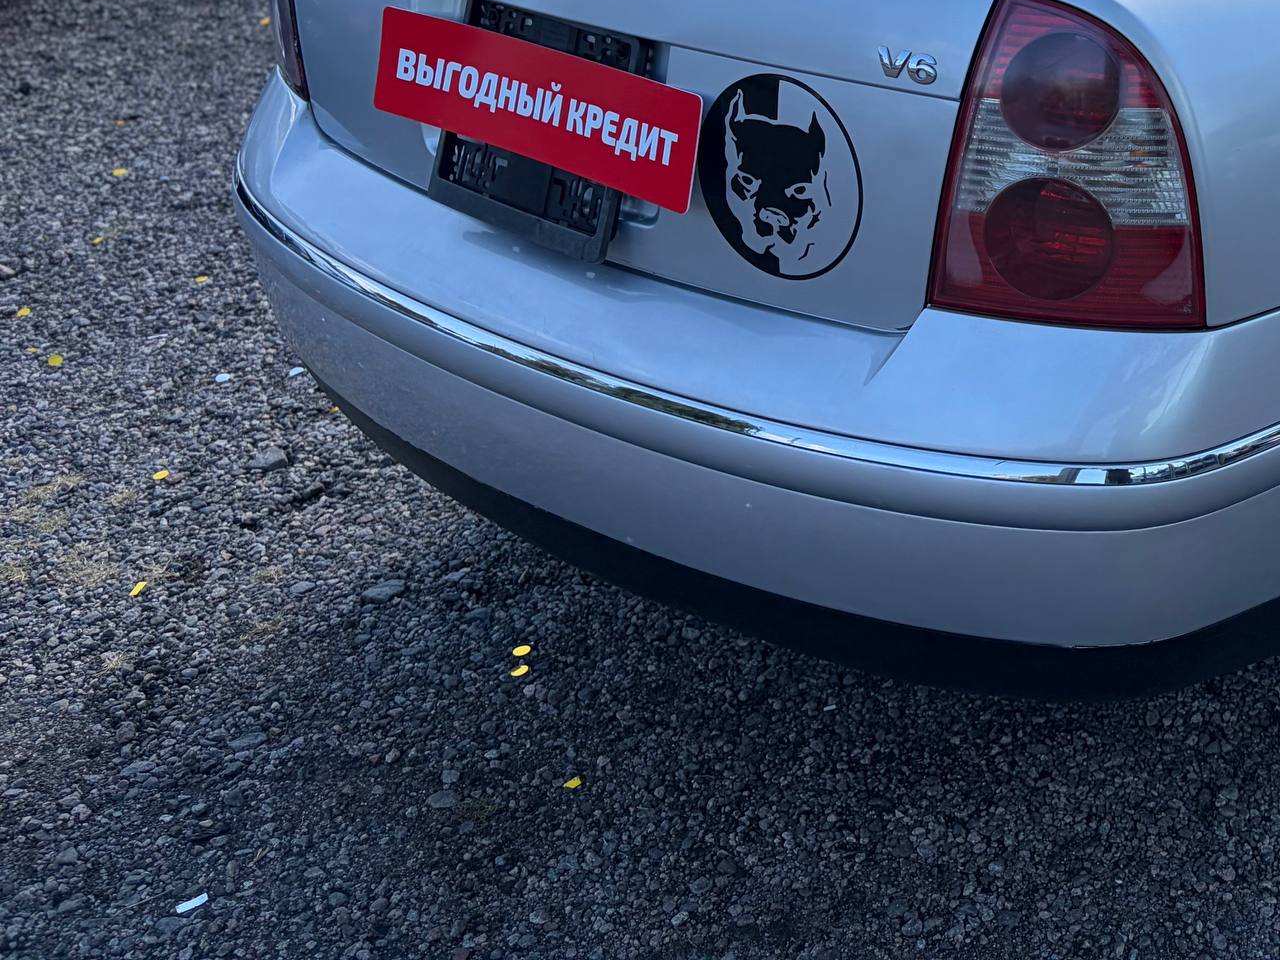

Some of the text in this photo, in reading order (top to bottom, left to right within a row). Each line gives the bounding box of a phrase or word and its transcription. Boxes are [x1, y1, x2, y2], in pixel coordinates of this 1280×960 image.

[877, 45, 938, 85] V6
[396, 48, 679, 166] ВЫГОДНЫЙ КРЕДИТ
